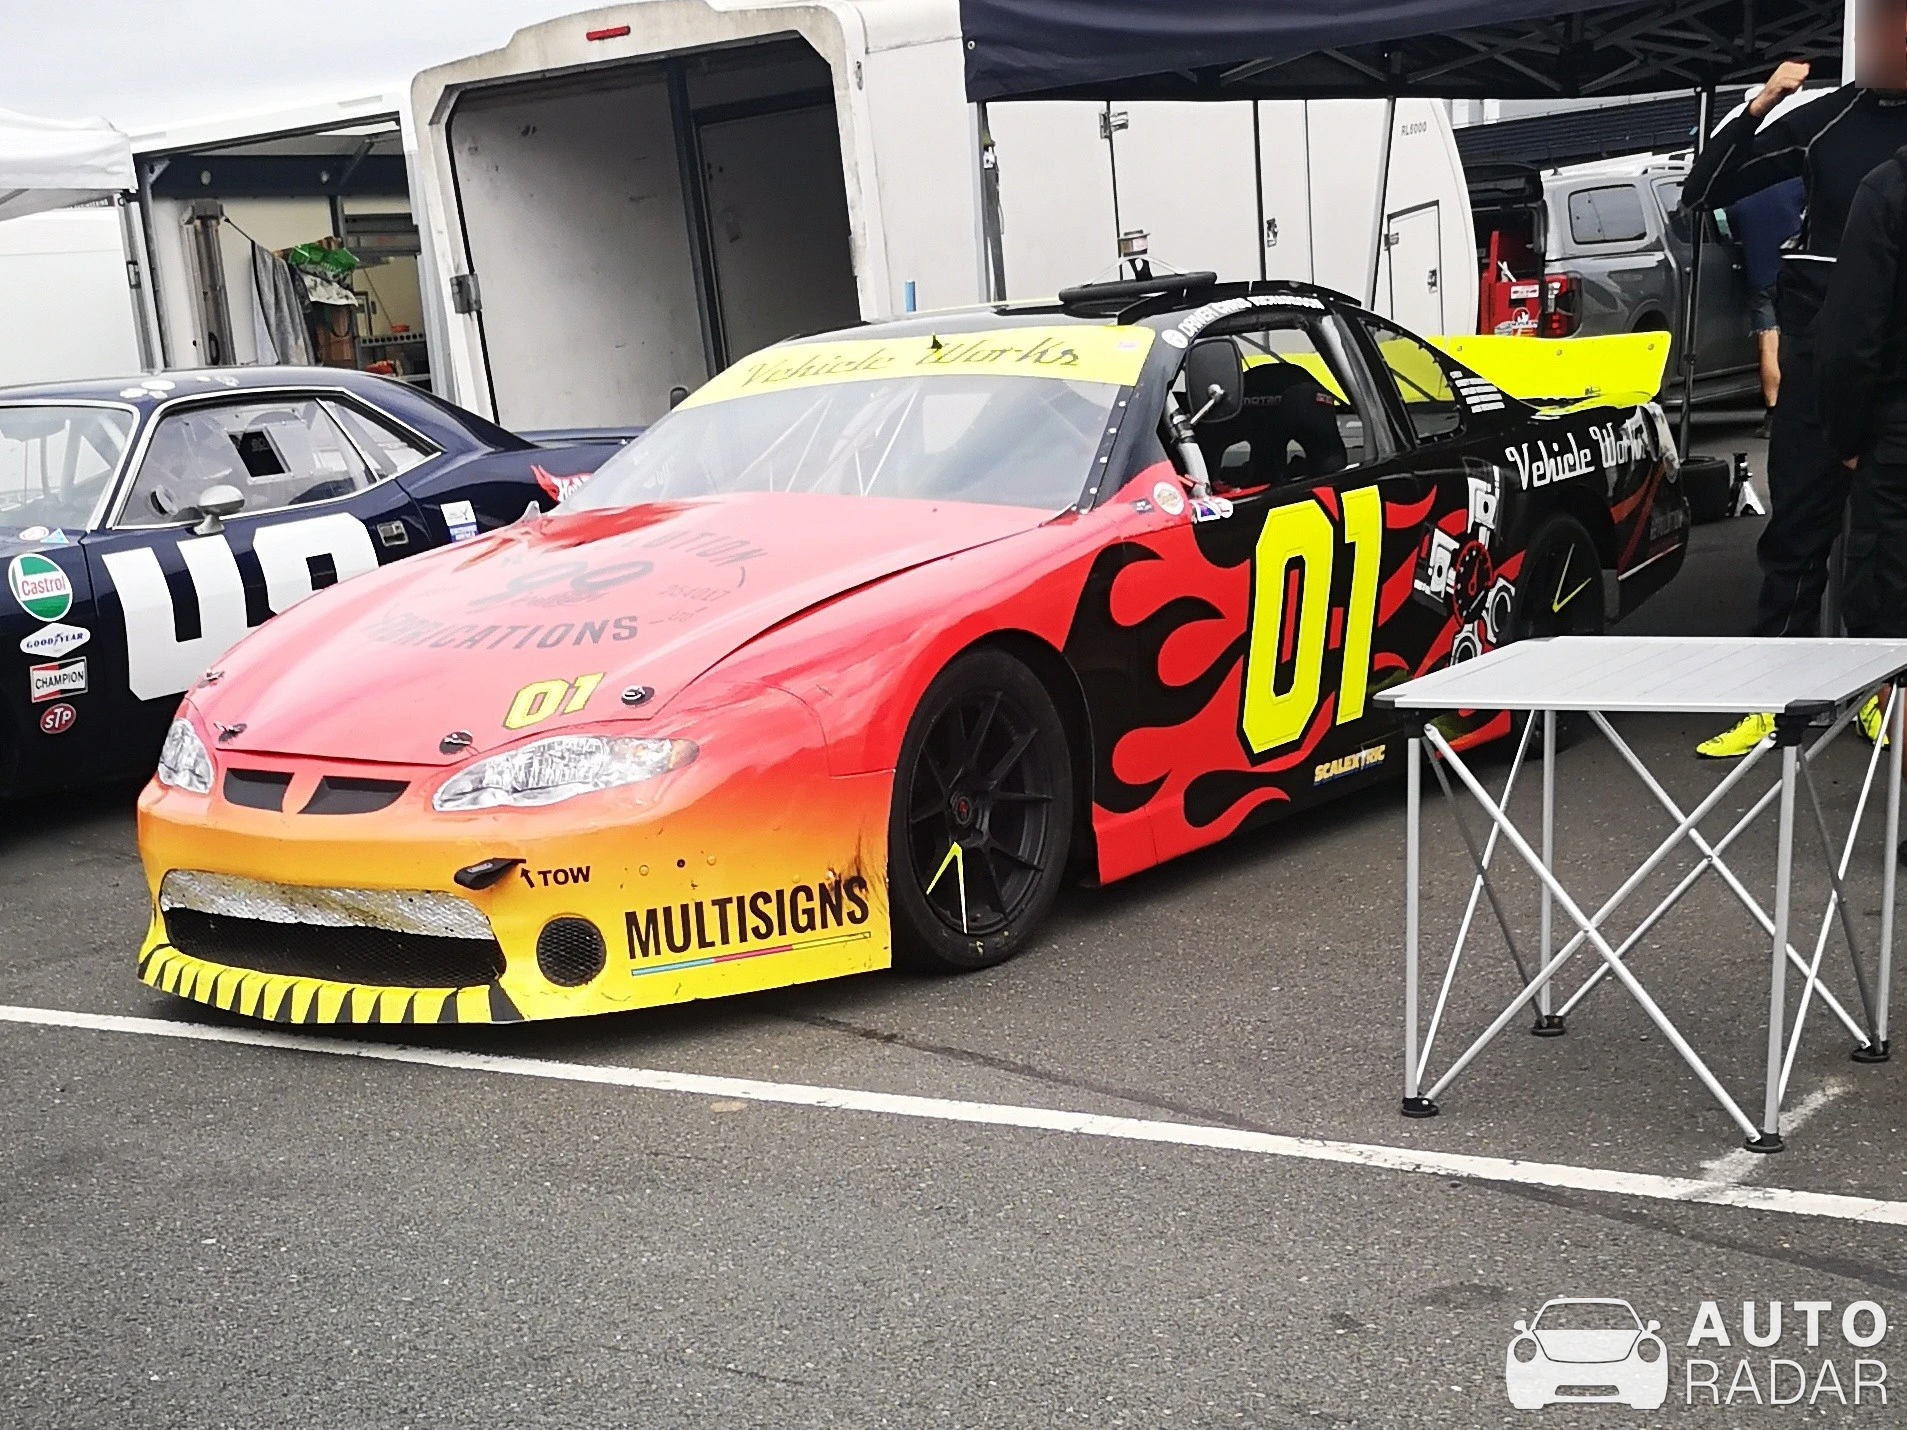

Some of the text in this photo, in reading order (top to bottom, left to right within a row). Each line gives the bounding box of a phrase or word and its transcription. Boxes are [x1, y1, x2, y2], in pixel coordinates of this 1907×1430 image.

[1178, 302, 1218, 338] DRIVER
[741, 337, 1081, 388] Vehicle Works
[1504, 432, 1596, 490] Vehicle
[21, 575, 66, 597] Castrol
[1242, 484, 1383, 754] 01
[26, 632, 84, 650] GOODYEAR
[35, 670, 85, 691] CHAMPION
[44, 707, 72, 729] STP
[503, 671, 605, 730] 01
[537, 866, 591, 888] TOW
[624, 876, 870, 960] MULTISIGNS
